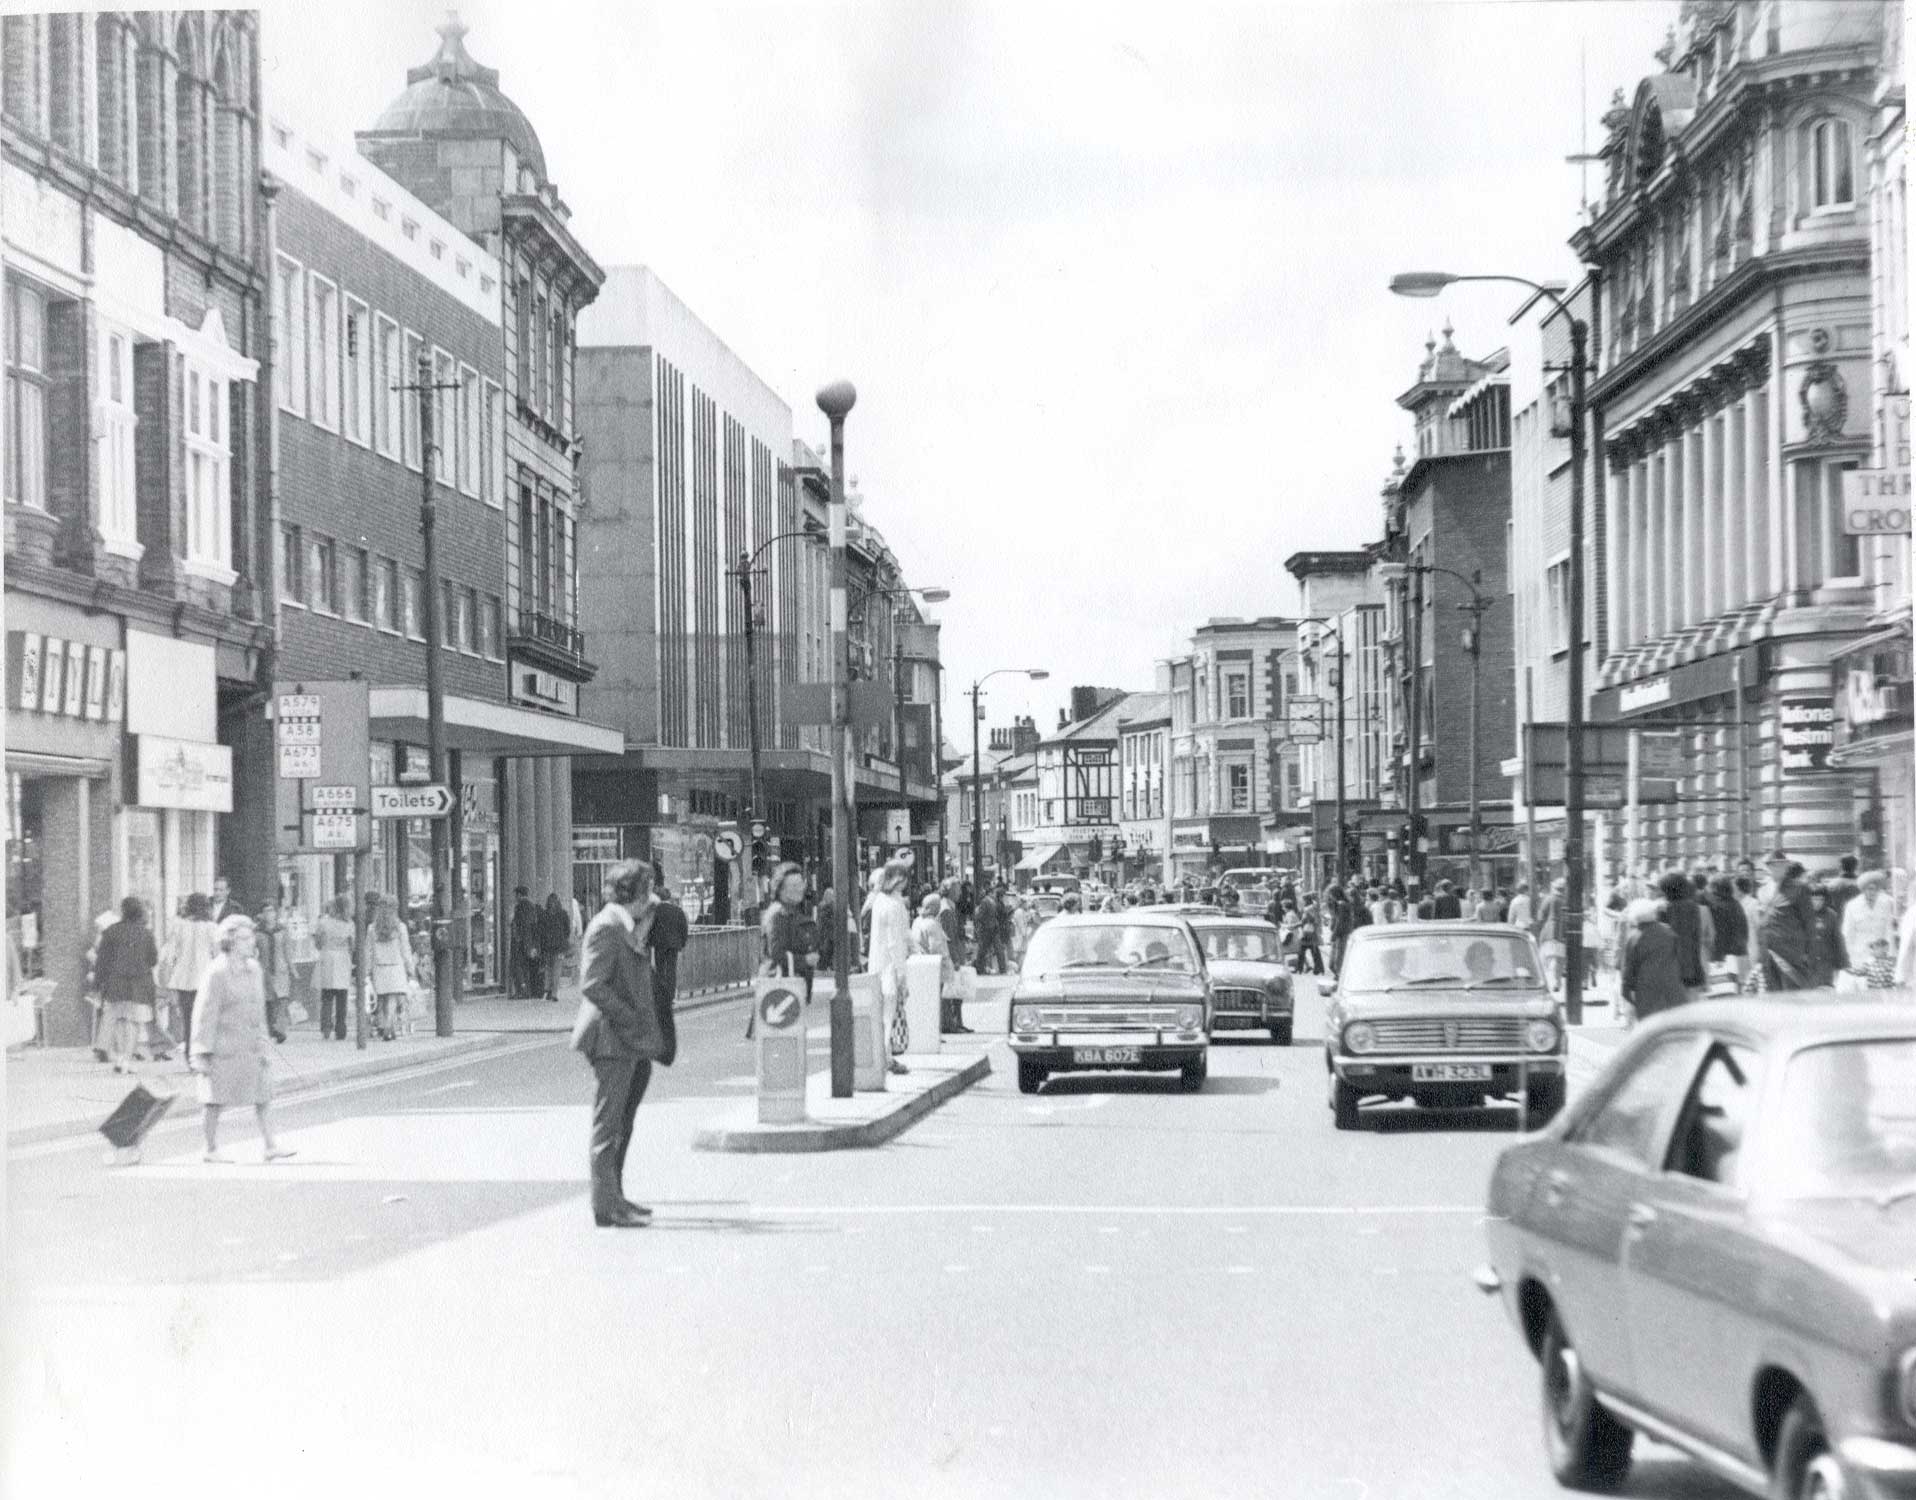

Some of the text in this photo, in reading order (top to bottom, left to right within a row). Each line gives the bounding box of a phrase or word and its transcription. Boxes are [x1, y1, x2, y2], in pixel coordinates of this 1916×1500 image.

[286, 725, 313, 737] A58
[283, 747, 317, 758] A673
[316, 787, 351, 800] A666
[378, 793, 436, 809] Toilets
[316, 815, 353, 828] A675
